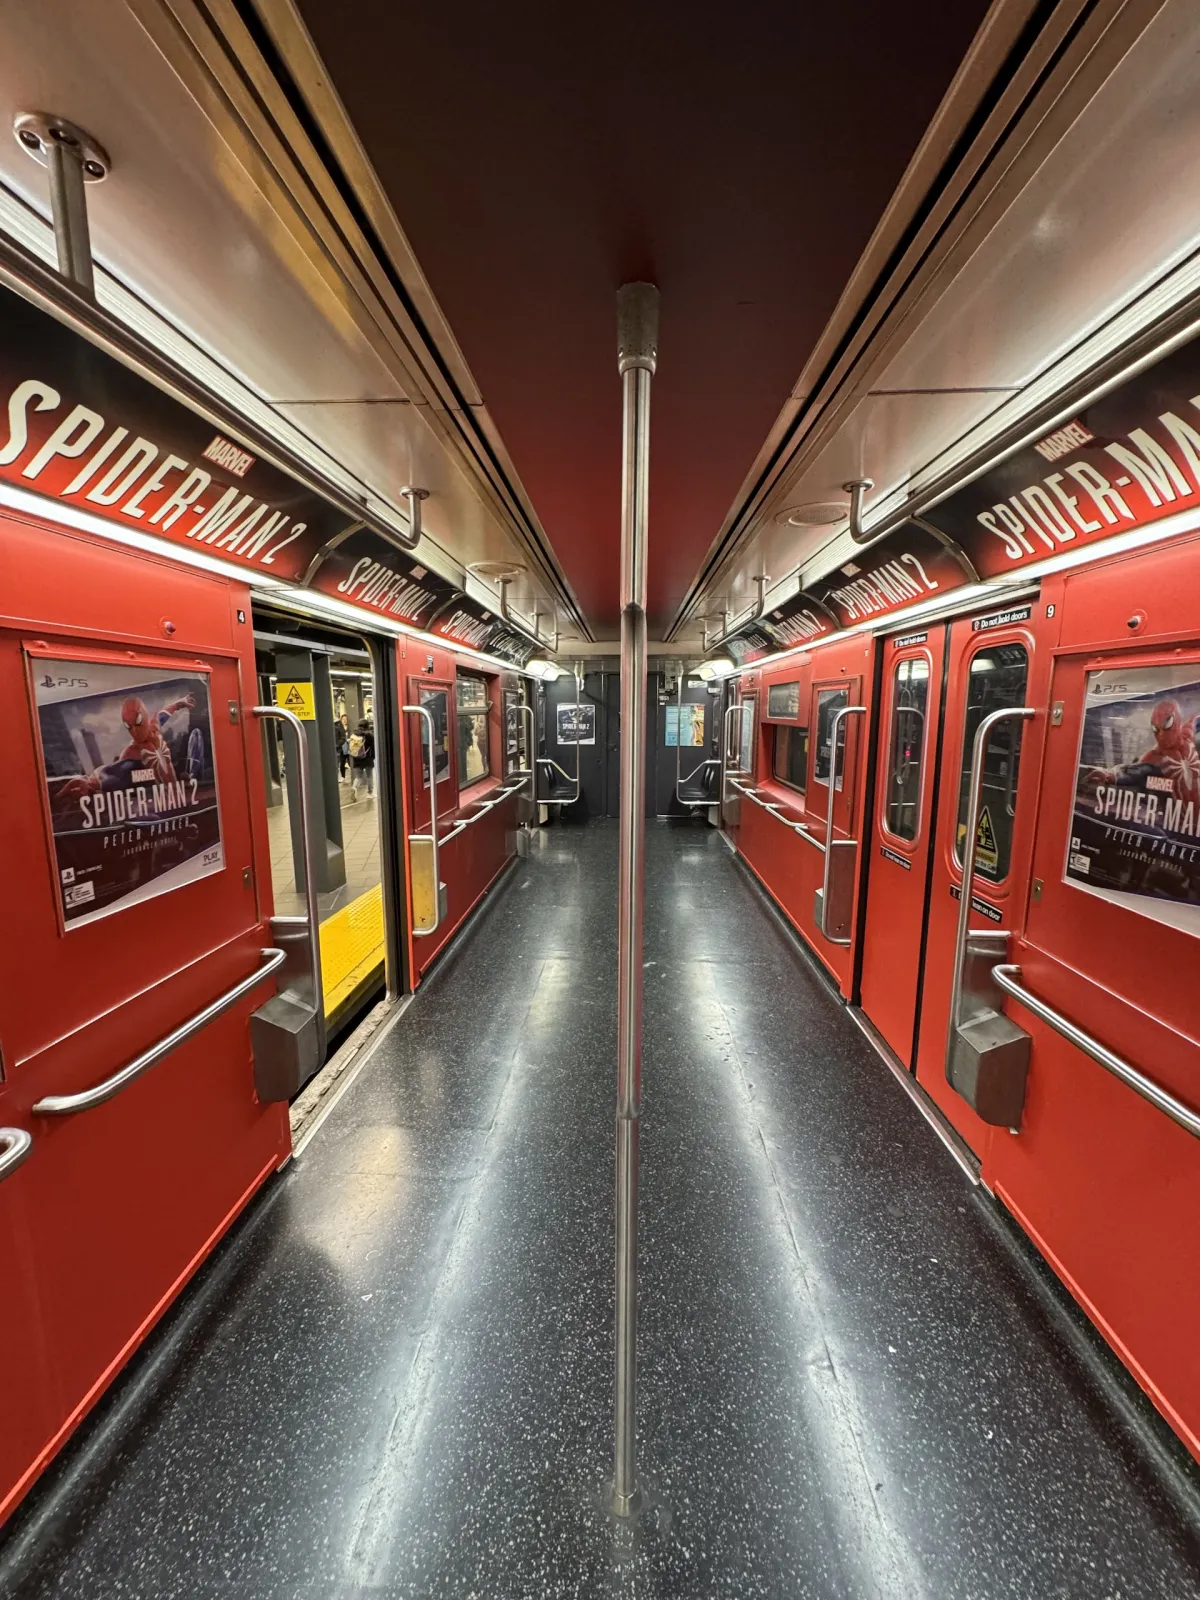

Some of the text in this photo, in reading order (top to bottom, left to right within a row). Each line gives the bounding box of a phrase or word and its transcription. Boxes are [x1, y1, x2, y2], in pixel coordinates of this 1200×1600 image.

[1034, 421, 1092, 462] MARVEL
[202, 436, 255, 477] MARVEL
[0, 380, 307, 564] SPIDER-MAN 2
[977, 395, 1200, 560] SPIDER-MA
[337, 557, 432, 618] SPIDER-MAN
[832, 553, 938, 620] SPIDER-MAN 2
[239, 611, 245, 622] 4
[802, 609, 826, 631] 2
[981, 619, 988, 629] Do
[989, 617, 998, 626] not
[1011, 611, 1027, 621] doors
[1047, 605, 1055, 618] 9
[58, 677, 89, 689] PS5
[1103, 684, 1128, 693] PS5
[131, 768, 155, 784] MARVEL
[1146, 775, 1174, 793] MARVEL
[80, 778, 199, 828] SPIDER-MAN 2
[104, 828, 142, 849] PETER
[151, 816, 189, 837] PARKER
[1104, 827, 1200, 864] PETER PARKE
[203, 851, 218, 862] PLAY
